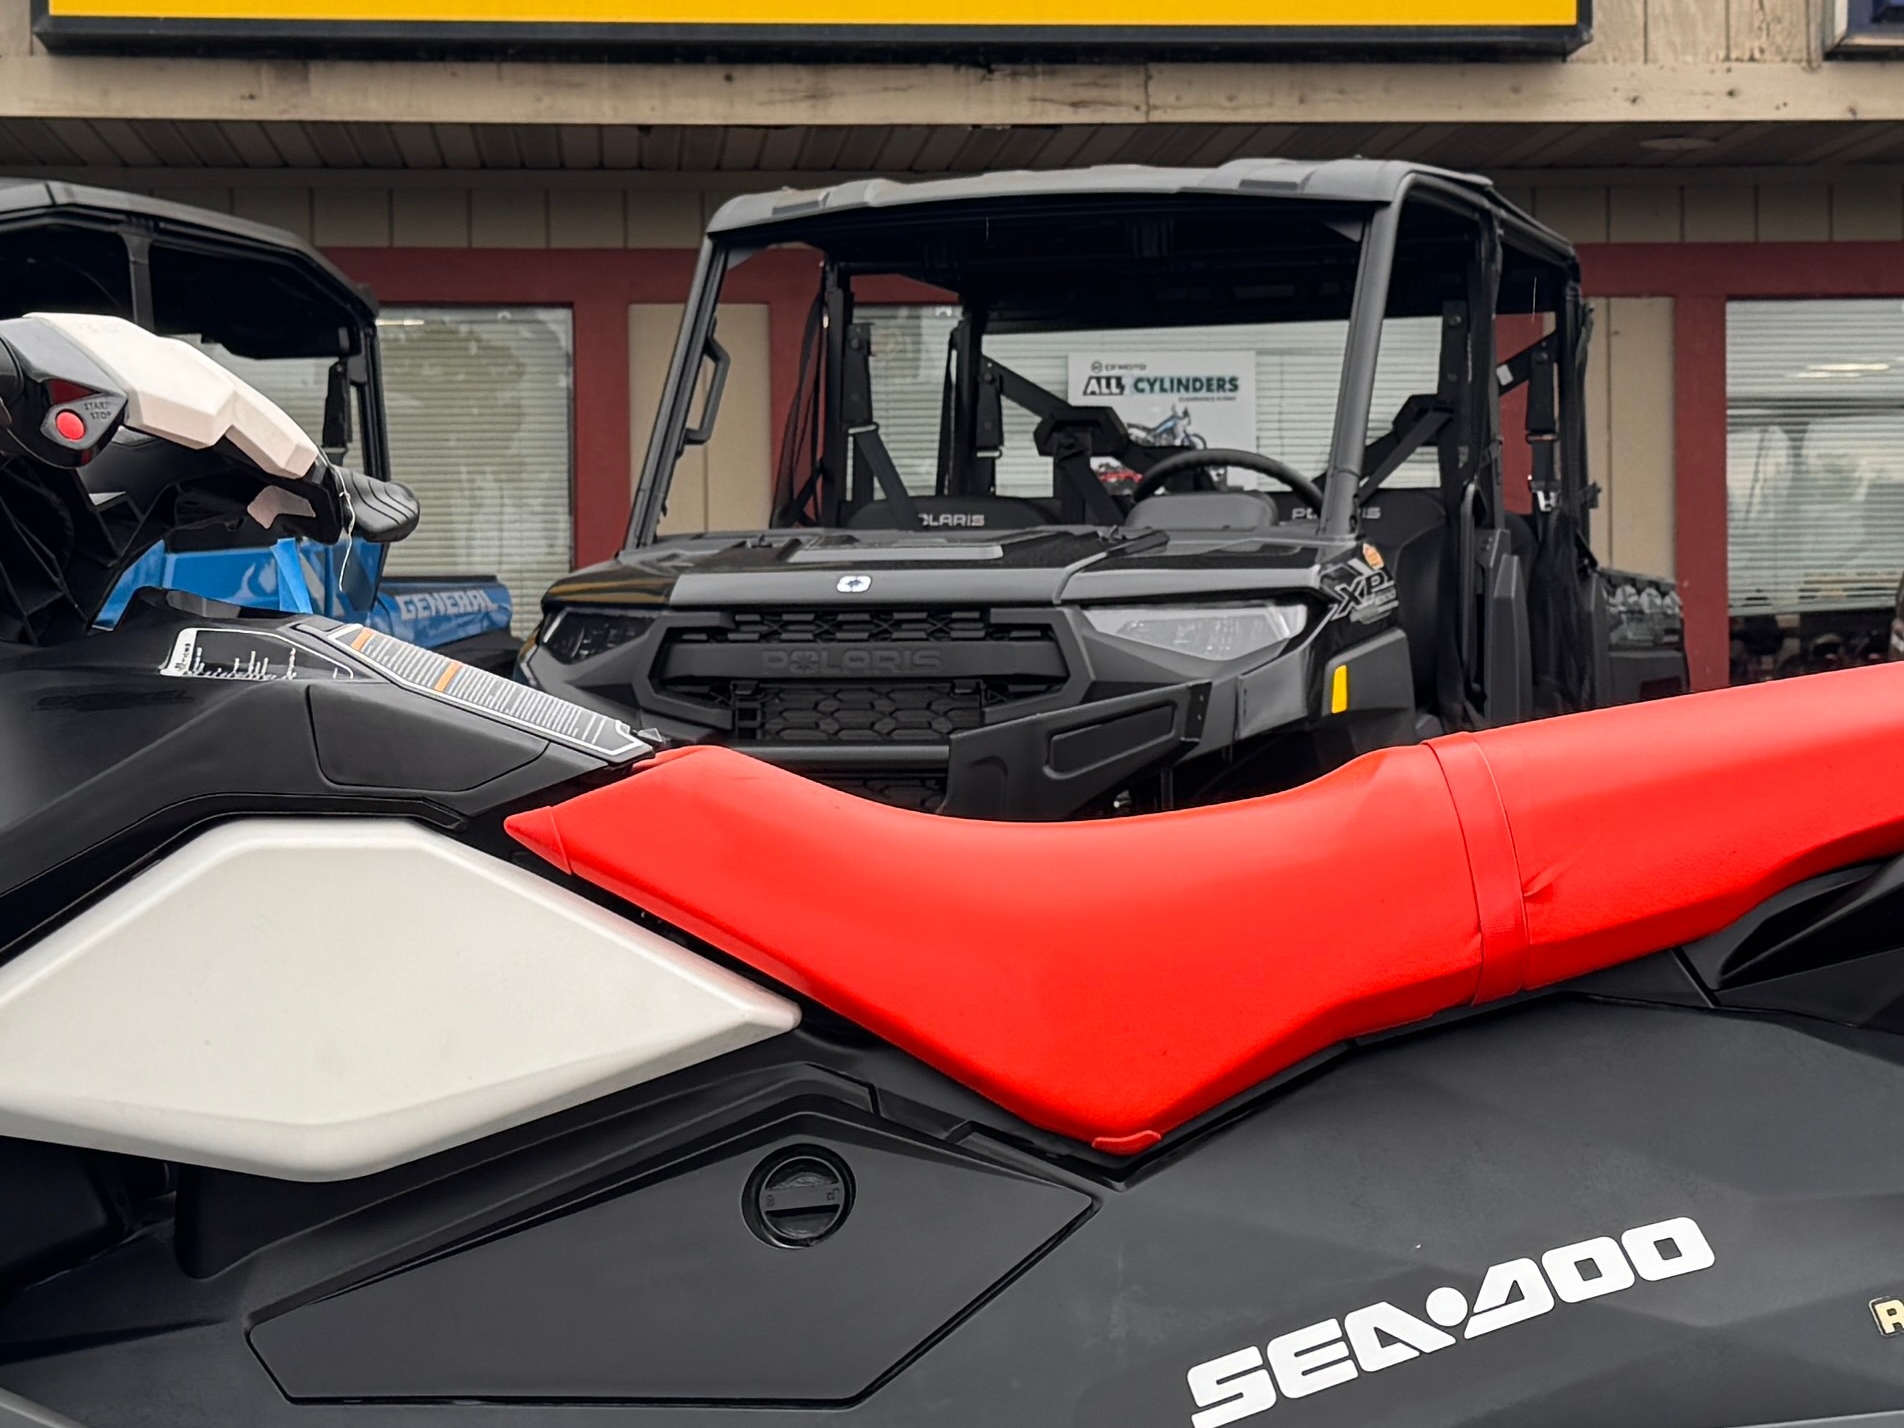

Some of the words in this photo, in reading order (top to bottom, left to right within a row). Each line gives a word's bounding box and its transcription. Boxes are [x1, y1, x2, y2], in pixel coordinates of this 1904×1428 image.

[1086, 377, 1124, 396] ALL
[1133, 376, 1239, 394] CYLINDERS
[395, 589, 499, 621] GENERAL
[762, 649, 944, 674] POLARIS
